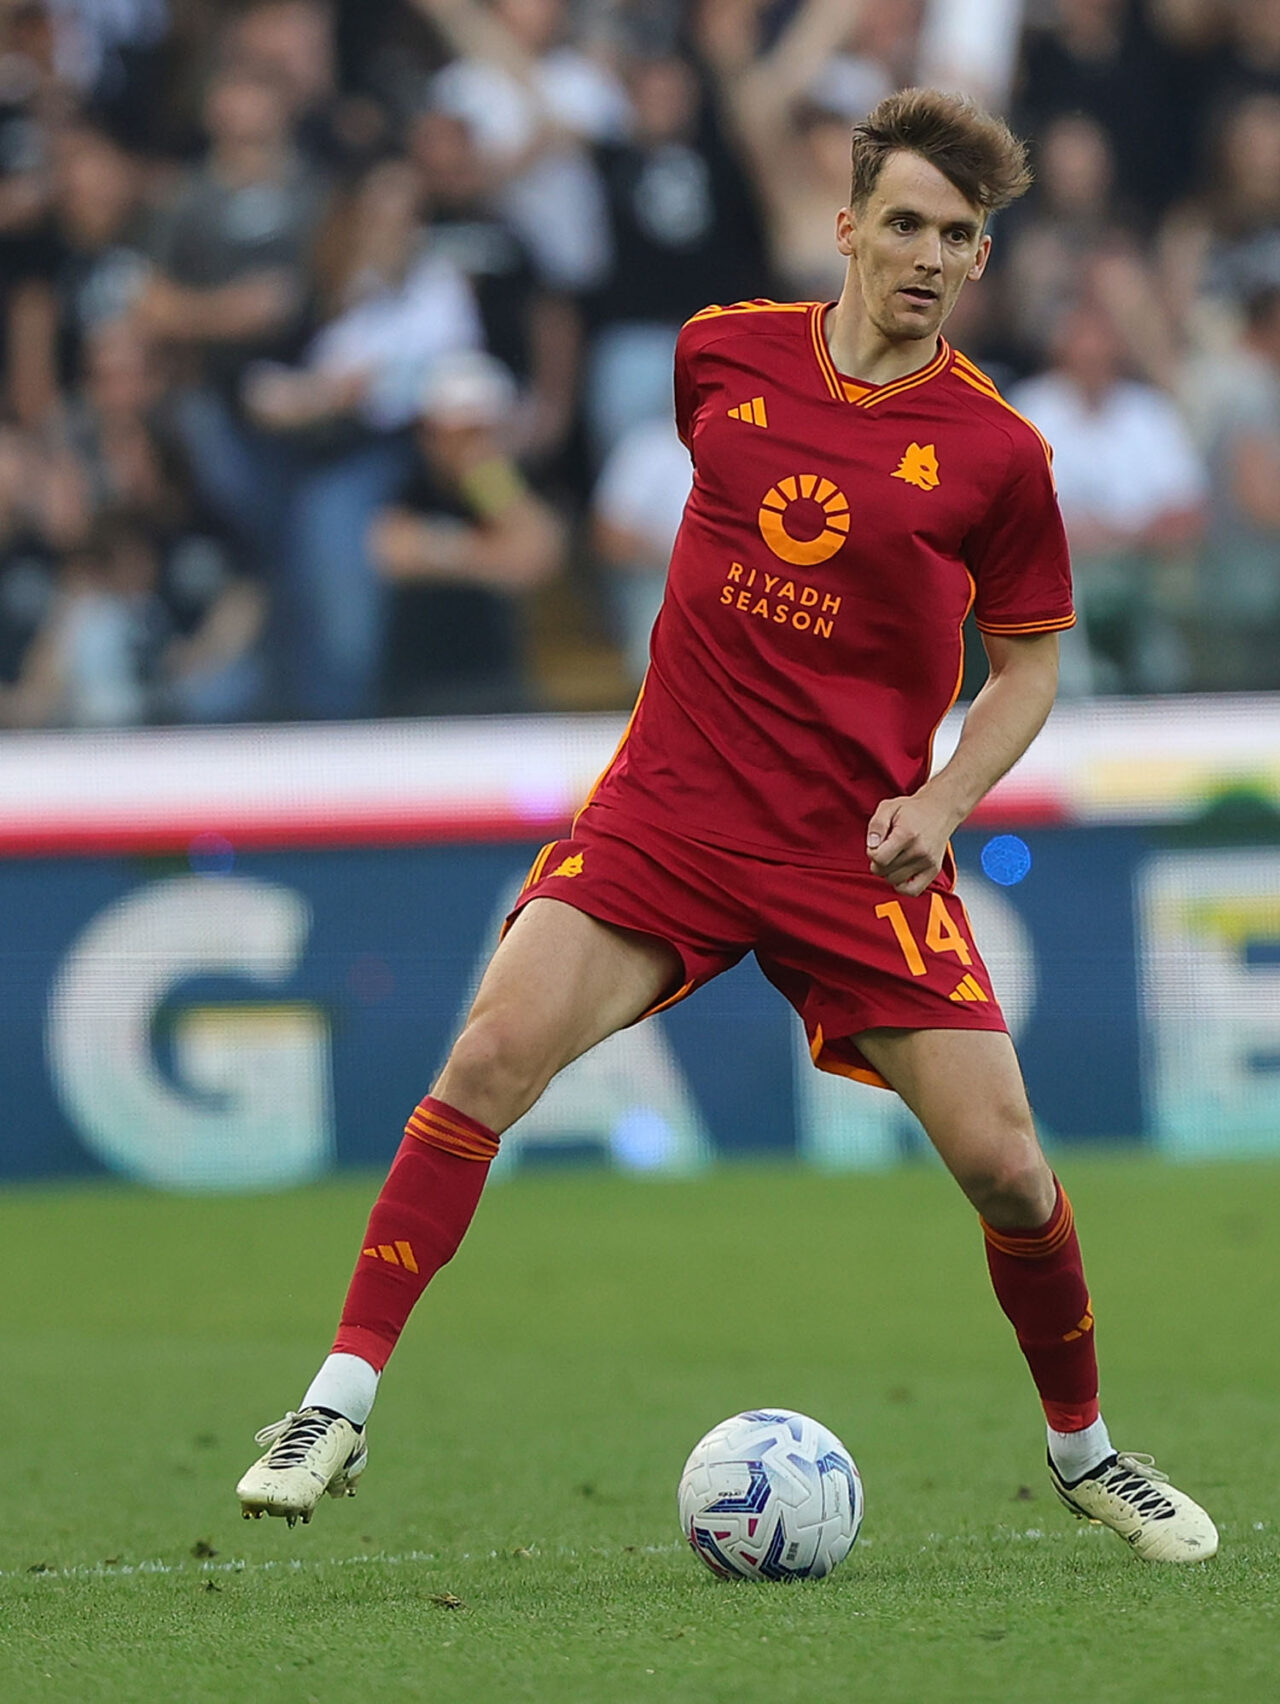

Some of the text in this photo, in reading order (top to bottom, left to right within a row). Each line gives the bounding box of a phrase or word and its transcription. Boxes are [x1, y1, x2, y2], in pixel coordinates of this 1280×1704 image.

[720, 585, 834, 639] SEASON
[727, 562, 841, 615] RIYADH
[875, 893, 973, 976] 14
